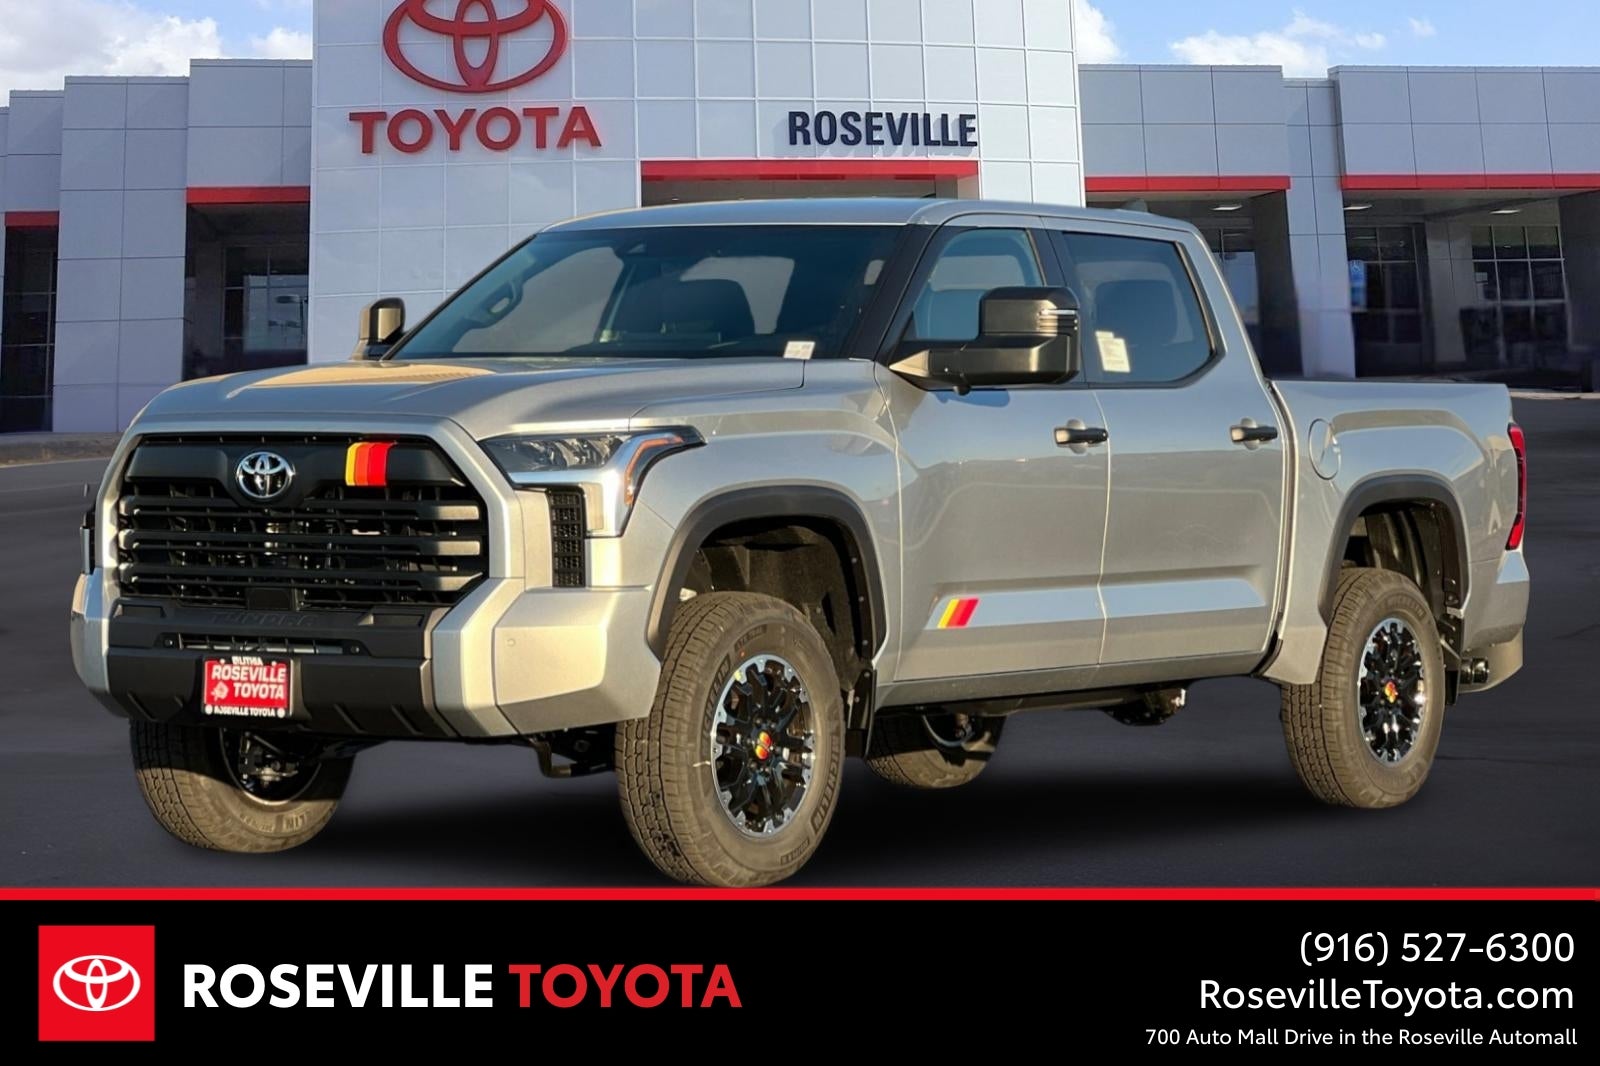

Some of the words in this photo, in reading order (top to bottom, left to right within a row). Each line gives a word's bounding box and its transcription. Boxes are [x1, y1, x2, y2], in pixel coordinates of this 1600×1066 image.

[349, 105, 602, 155] TOYOTA
[788, 110, 978, 148] ROSEVILLE
[211, 665, 287, 683] ROSEVILLE
[233, 682, 285, 700] TOYOTA
[214, 705, 249, 717] ROSEVILLE
[250, 707, 276, 718] TOYOTA
